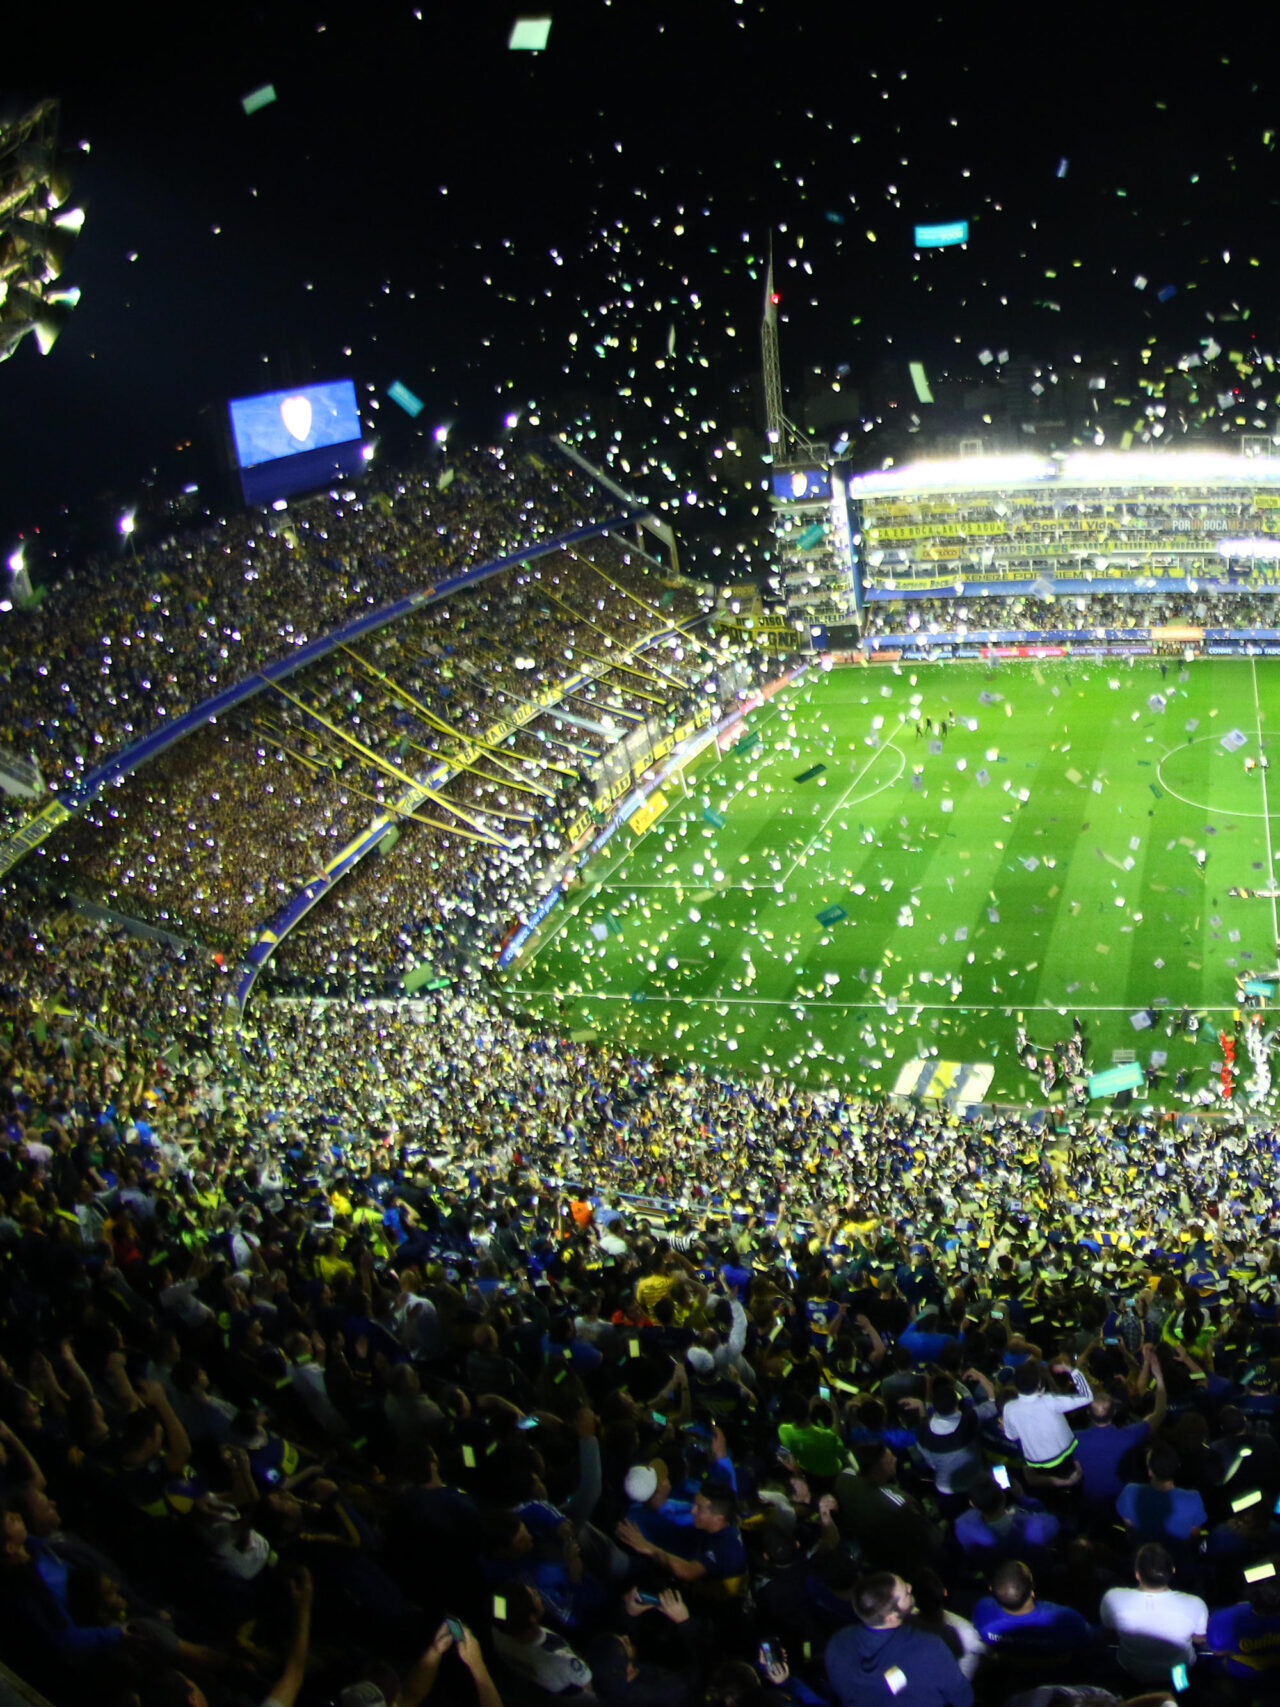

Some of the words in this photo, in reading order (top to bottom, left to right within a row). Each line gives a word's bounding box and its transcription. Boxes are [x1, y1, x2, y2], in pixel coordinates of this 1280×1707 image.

[1033, 522, 1064, 531] Boca
[1087, 521, 1114, 531] Vida
[1173, 520, 1190, 531] POR
[1204, 520, 1227, 531] BOCA
